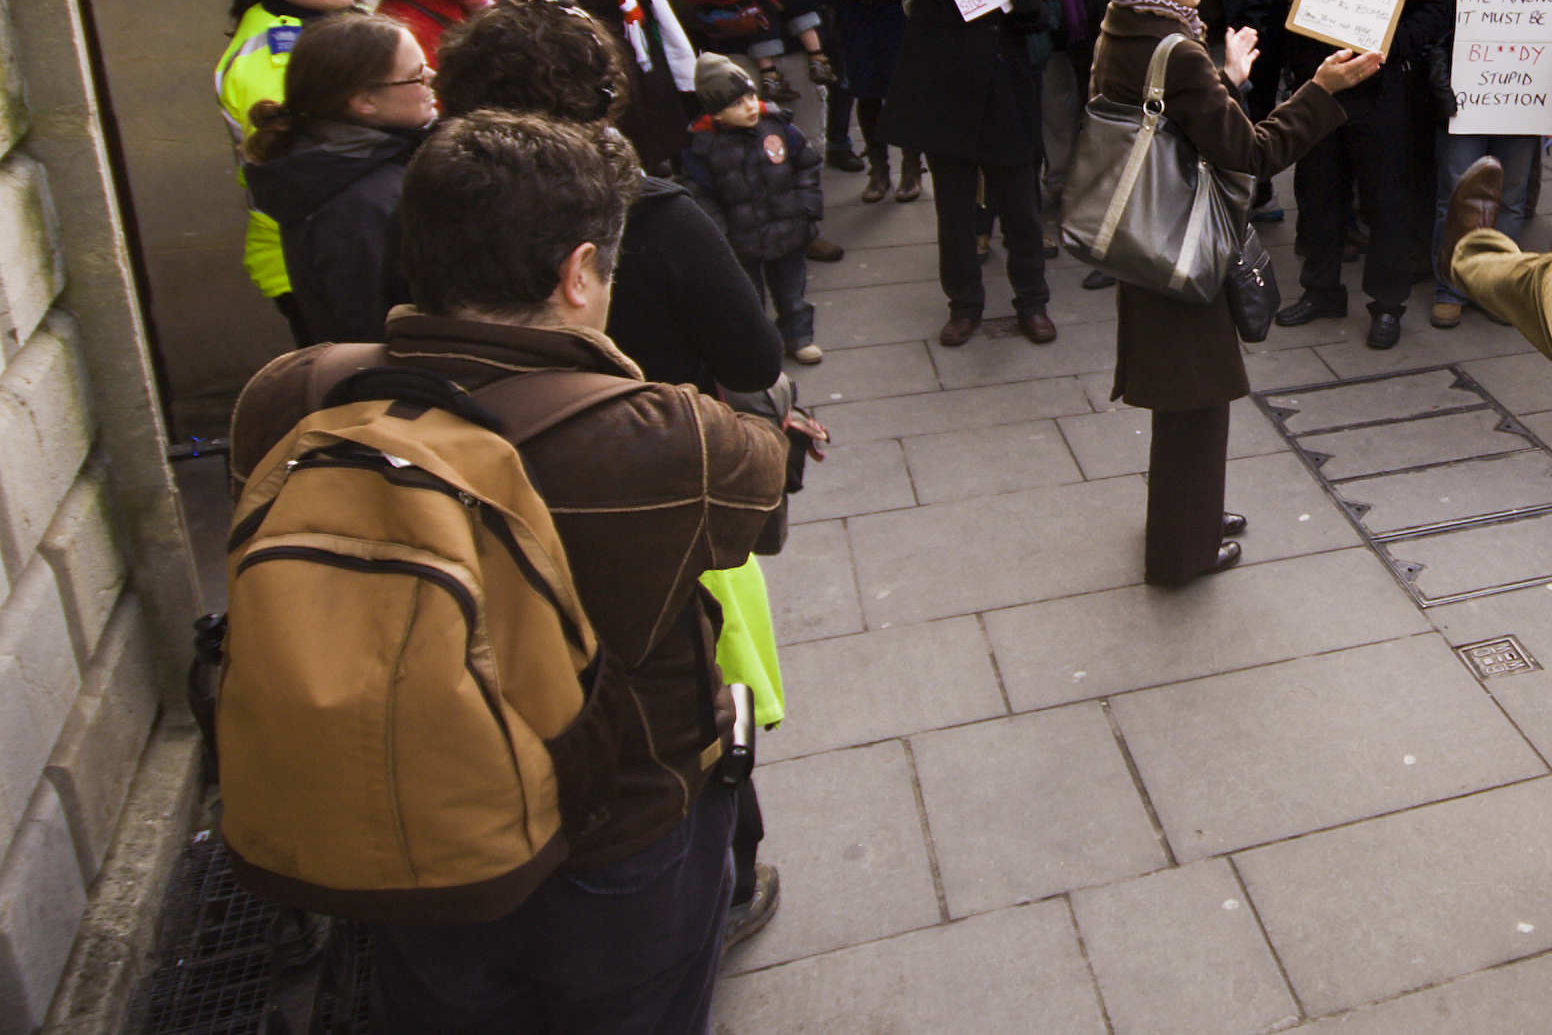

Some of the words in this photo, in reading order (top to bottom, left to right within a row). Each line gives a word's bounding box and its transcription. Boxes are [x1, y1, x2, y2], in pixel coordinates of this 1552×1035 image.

[1458, 10, 1476, 24] IT
[1481, 11, 1524, 25] MUST
[1529, 10, 1548, 26] BE
[1478, 70, 1533, 86] STUPID
